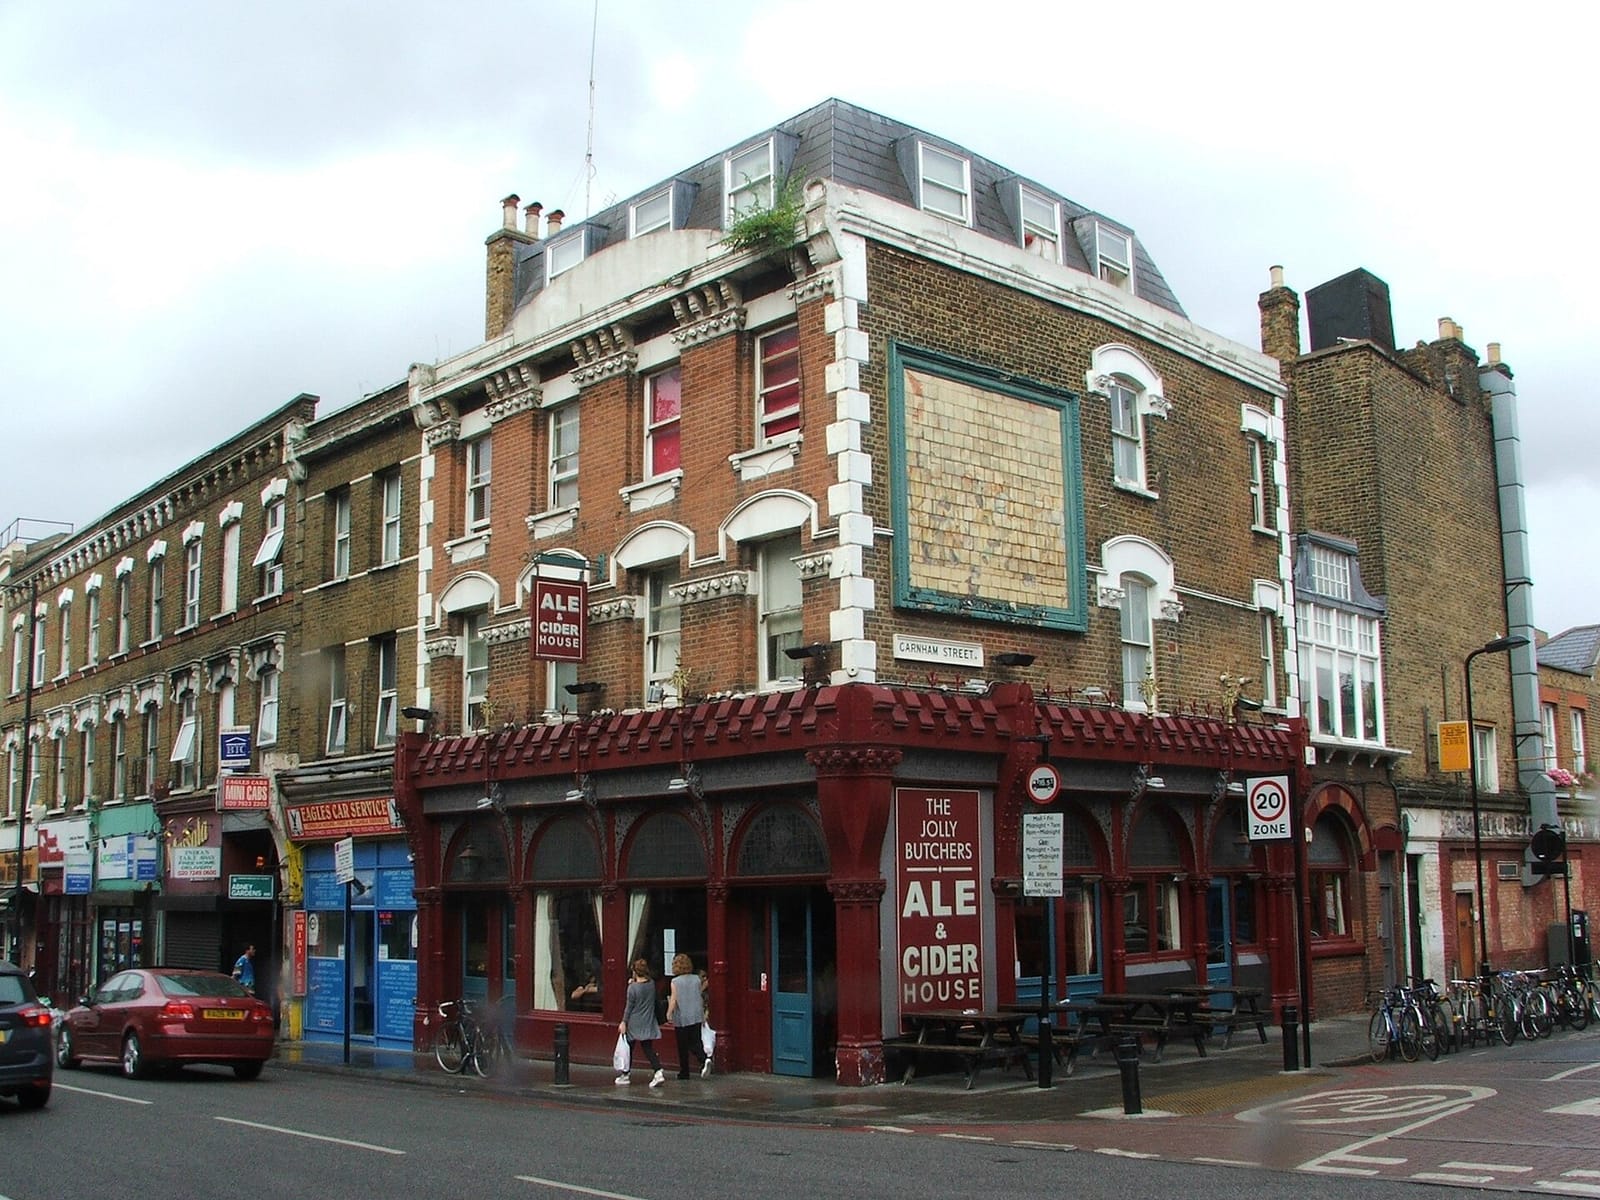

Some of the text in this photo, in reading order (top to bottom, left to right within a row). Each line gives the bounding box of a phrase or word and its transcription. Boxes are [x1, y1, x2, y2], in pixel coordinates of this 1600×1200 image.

[540, 592, 580, 613] ALE
[556, 612, 563, 621] &
[539, 621, 579, 636] CIDER
[539, 635, 579, 648] HOUSE
[225, 785, 268, 801] MINI CABS
[1256, 792, 1281, 810] 20
[300, 799, 387, 821] EAGLES CAR SERVICE
[926, 798, 951, 816] THE
[920, 820, 958, 838] JOLLY
[1253, 823, 1286, 835] ZONE
[905, 842, 972, 860] BUTCHERS
[231, 889, 262, 897] GARDENS
[902, 880, 977, 918] ALE
[935, 922, 947, 940] &
[902, 943, 979, 977] CIDER
[904, 978, 980, 1004] HOUSE
